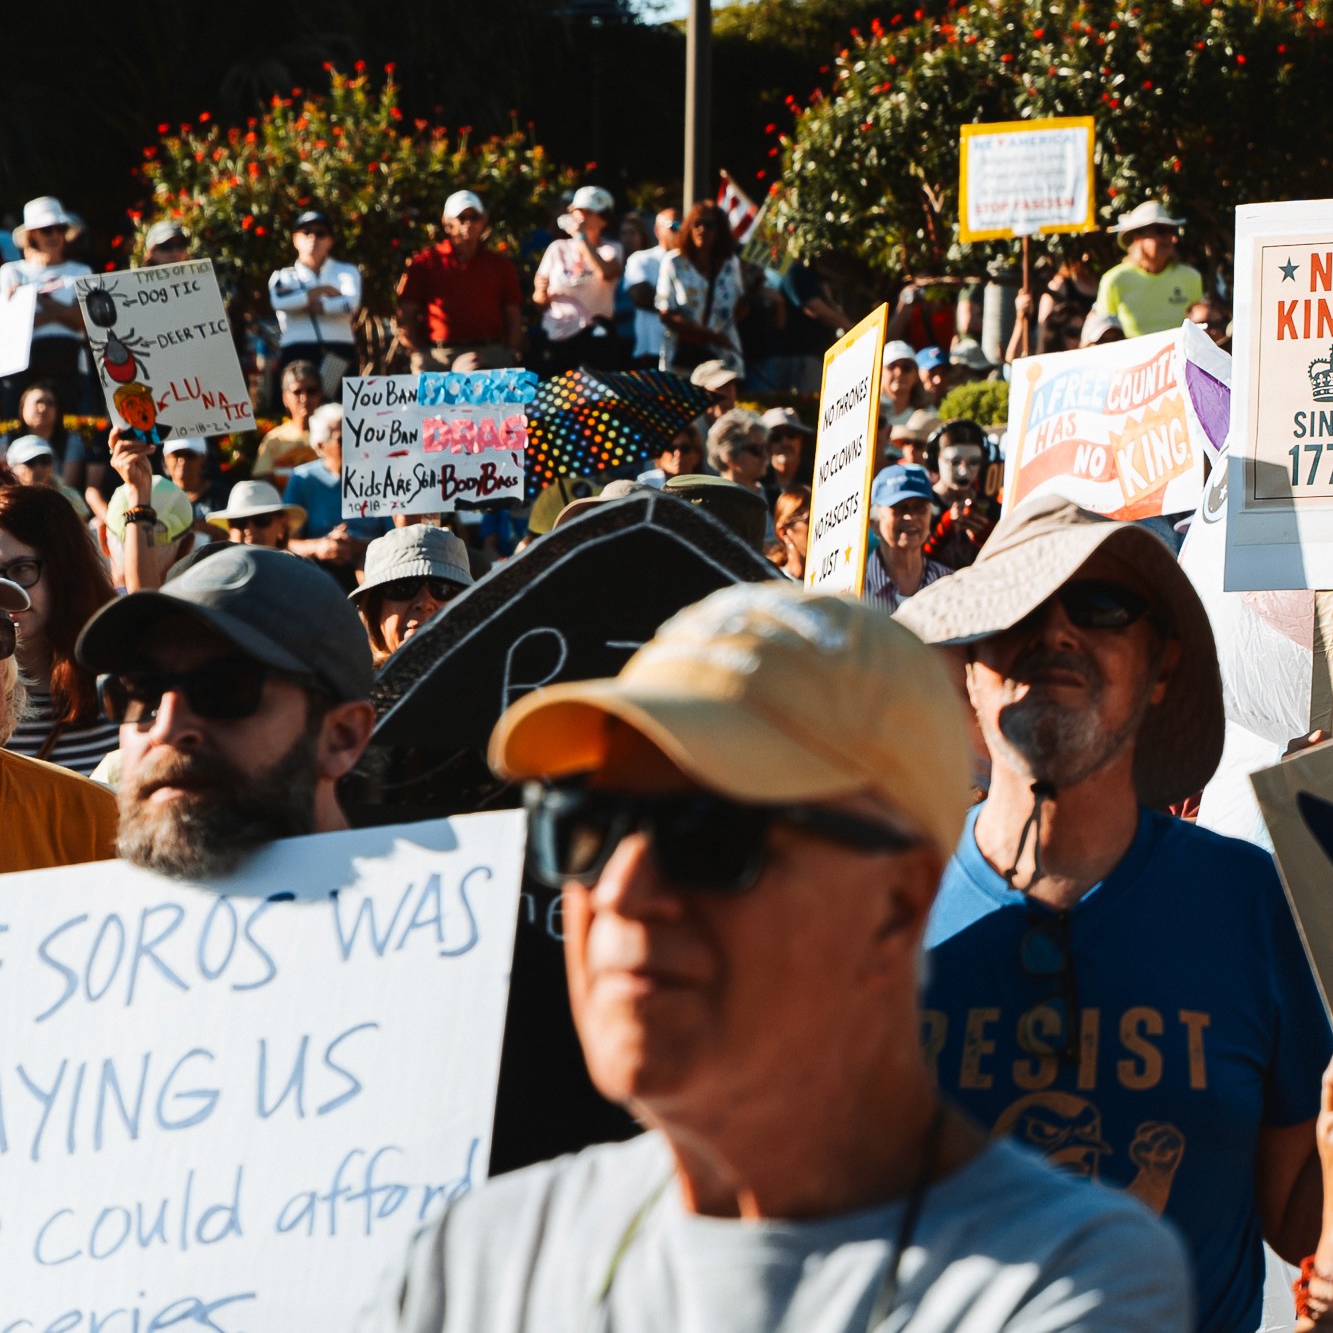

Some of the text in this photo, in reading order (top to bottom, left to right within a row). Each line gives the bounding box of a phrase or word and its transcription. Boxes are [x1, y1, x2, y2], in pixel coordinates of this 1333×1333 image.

[133, 267, 171, 284] TYPES
[170, 279, 201, 298] TIC
[156, 318, 228, 350] DEER TIC
[822, 376, 869, 432] NO THRONES
[1047, 368, 1105, 411] FREE
[422, 414, 529, 455] DRAG
[1035, 412, 1077, 455] HAS
[343, 465, 382, 499] Kids
[818, 434, 863, 489] NO CLOWNS
[1073, 444, 1107, 478] NO
[813, 491, 860, 546] NO FASCISTS
[818, 548, 840, 583] JUST
[33, 892, 297, 1023] SOROS
[328, 865, 493, 963] WAS
[919, 1006, 1212, 1092] RESIST
[257, 1022, 381, 1120] US
[34, 1136, 480, 1266] could afford
